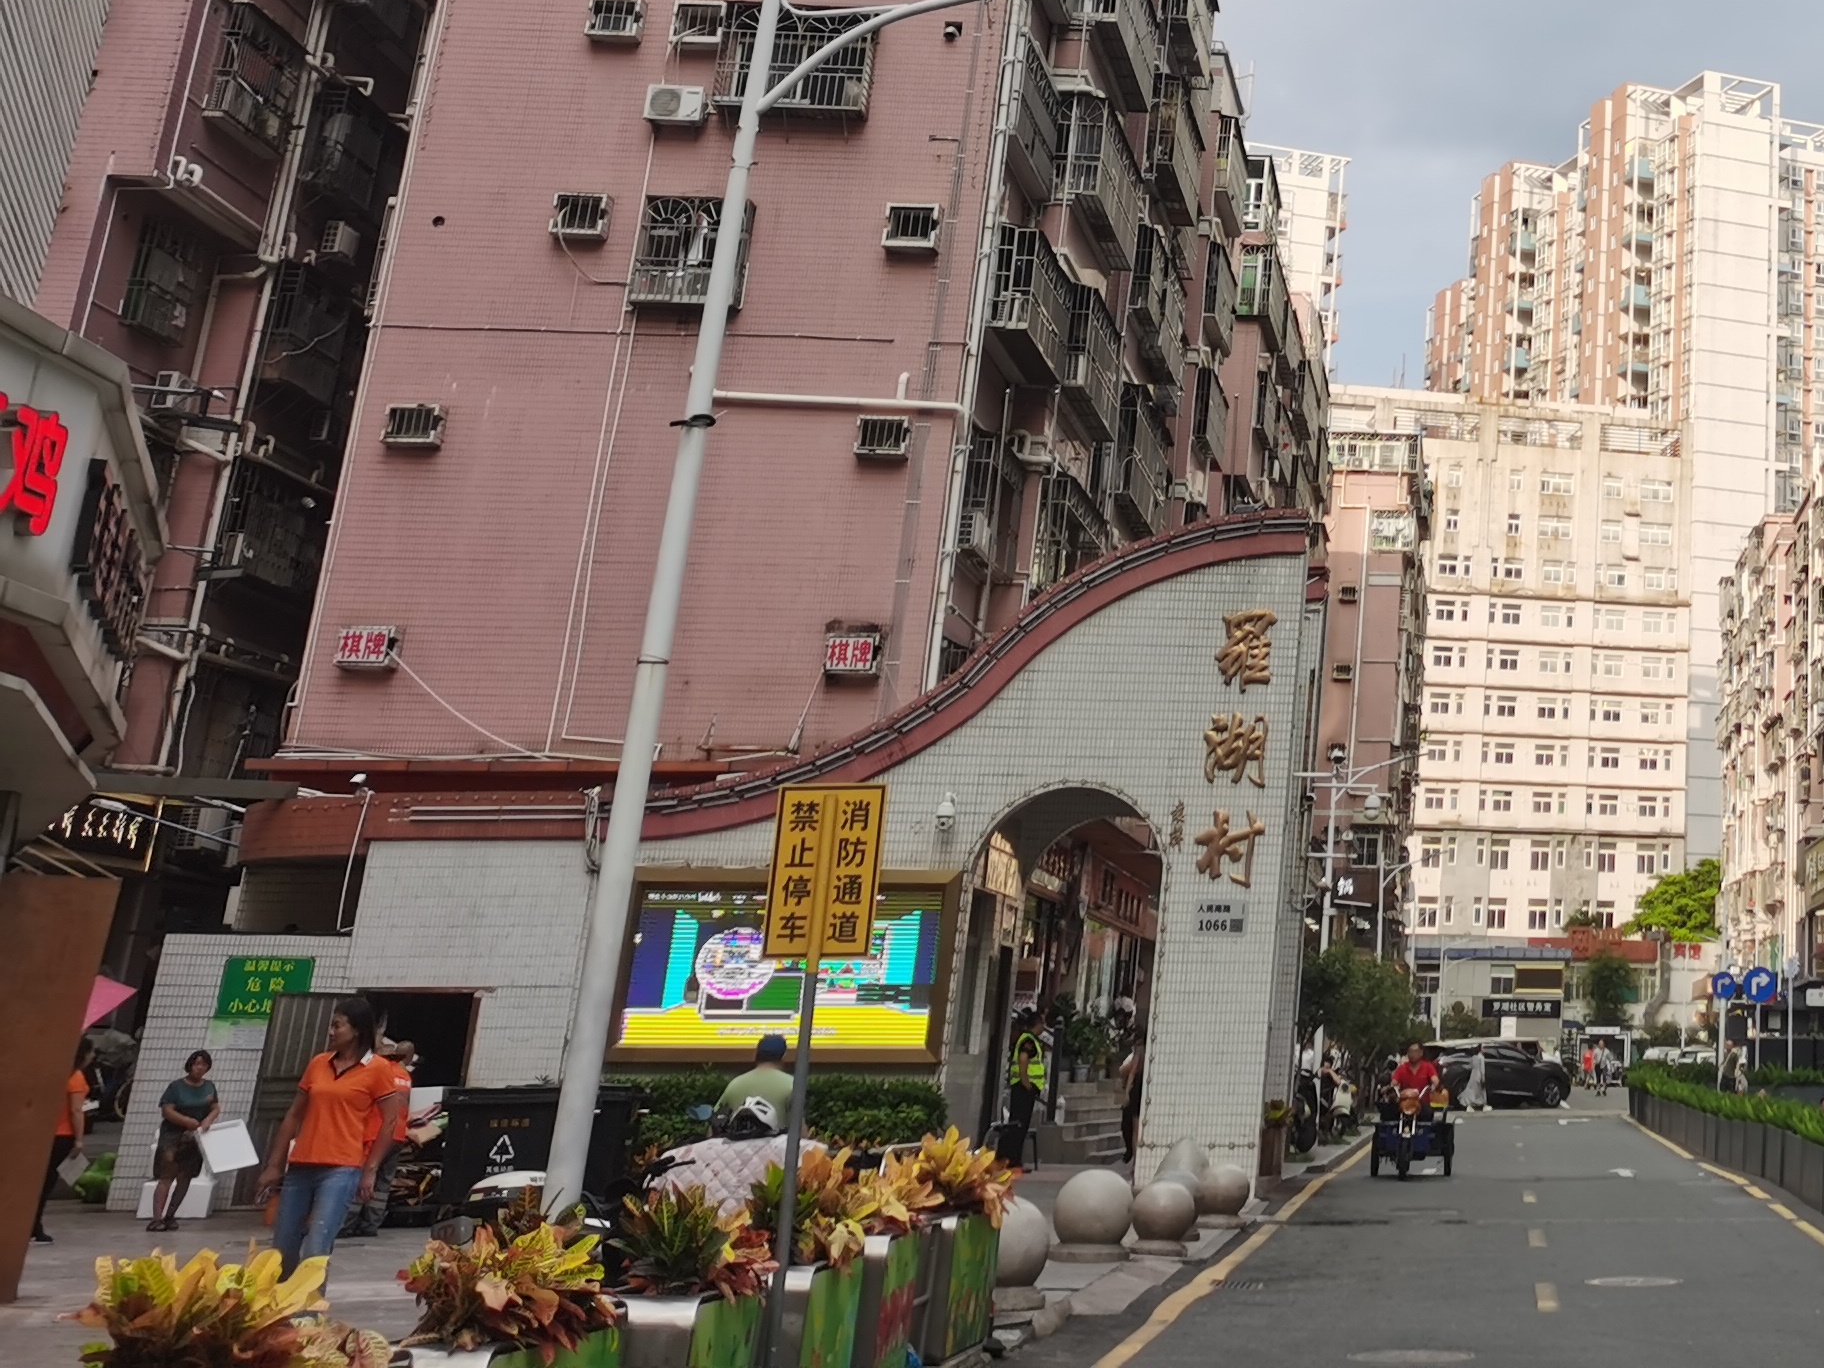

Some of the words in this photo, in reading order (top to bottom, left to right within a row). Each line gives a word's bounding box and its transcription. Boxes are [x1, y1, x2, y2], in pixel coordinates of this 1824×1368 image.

[0, 391, 68, 536] 鸡
[339, 632, 386, 660] 棋牌
[827, 636, 874, 669] 棋牌
[1195, 609, 1278, 889] 羅湖村
[775, 799, 820, 945] 禁止停车
[826, 799, 872, 945] 消防通道
[1197, 903, 1231, 913] 人民南路
[1197, 918, 1228, 932] 1066
[246, 976, 285, 992] 危险
[227, 998, 273, 1014] 小心地
